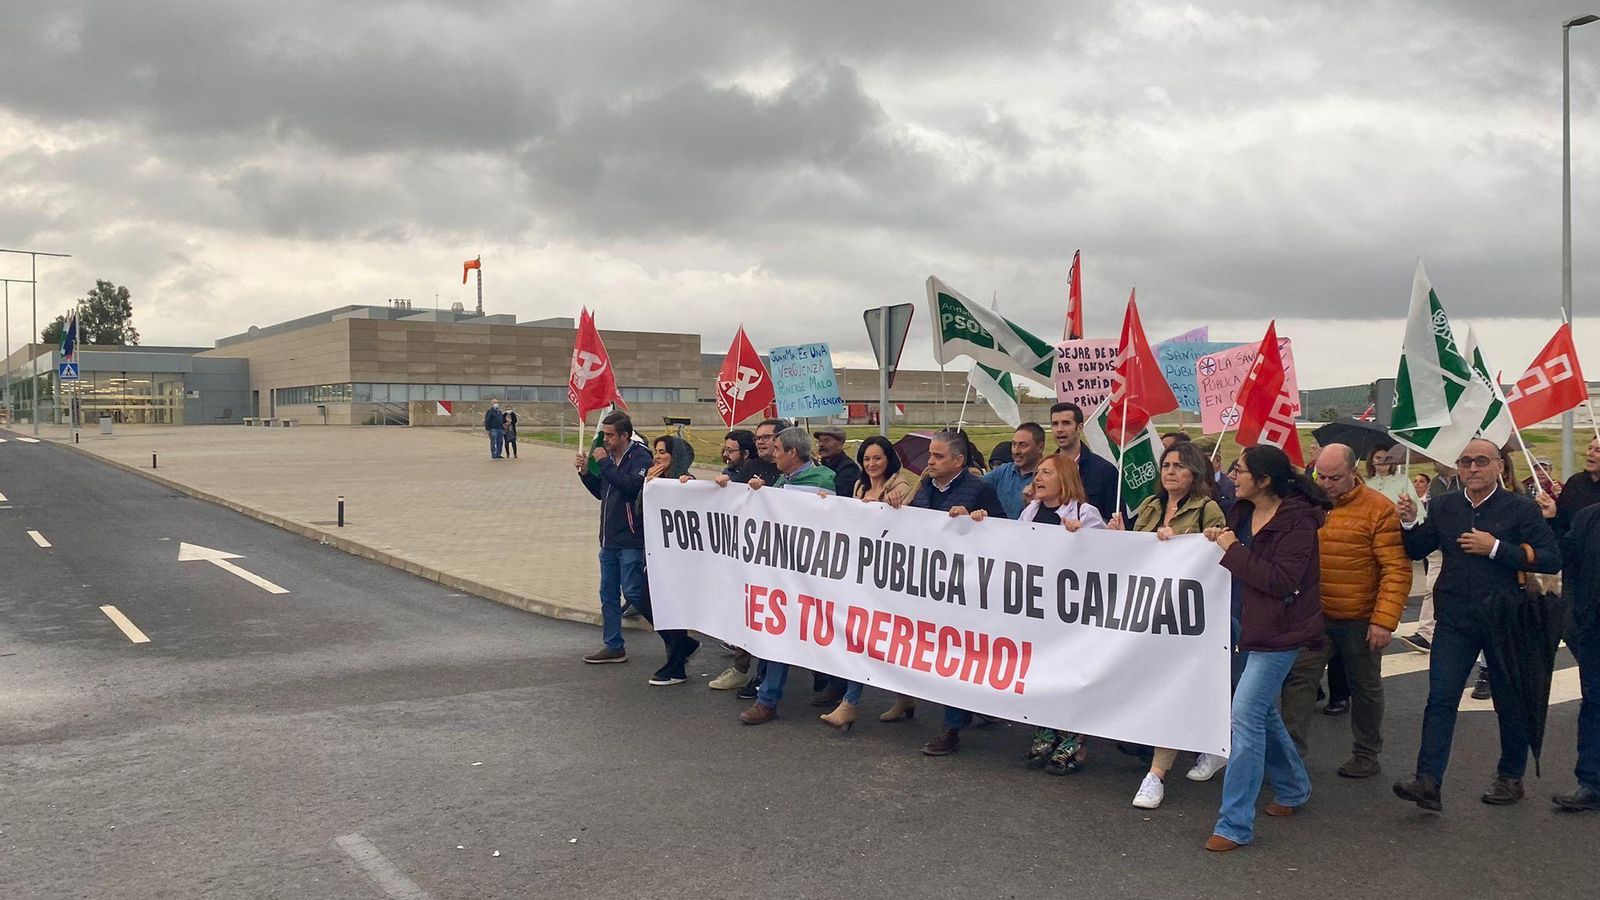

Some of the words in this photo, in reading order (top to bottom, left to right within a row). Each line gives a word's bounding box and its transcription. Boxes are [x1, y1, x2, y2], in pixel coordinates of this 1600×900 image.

[1094, 347, 1107, 360] DE
[1218, 358, 1232, 371] LA
[1062, 380, 1075, 393] LA
[1169, 382, 1196, 395] AGO
[1205, 394, 1222, 407] EN
[660, 508, 704, 551] POR
[706, 512, 739, 560] UNA
[742, 518, 850, 581] SANIDAD
[856, 529, 967, 606] PÚBLICA
[977, 556, 995, 610] Y
[1003, 560, 1044, 620] DE
[1056, 568, 1206, 637] CALIDAD
[744, 583, 788, 636] ¡ES
[797, 593, 835, 647] TU
[845, 605, 1032, 695] DERECHO!
